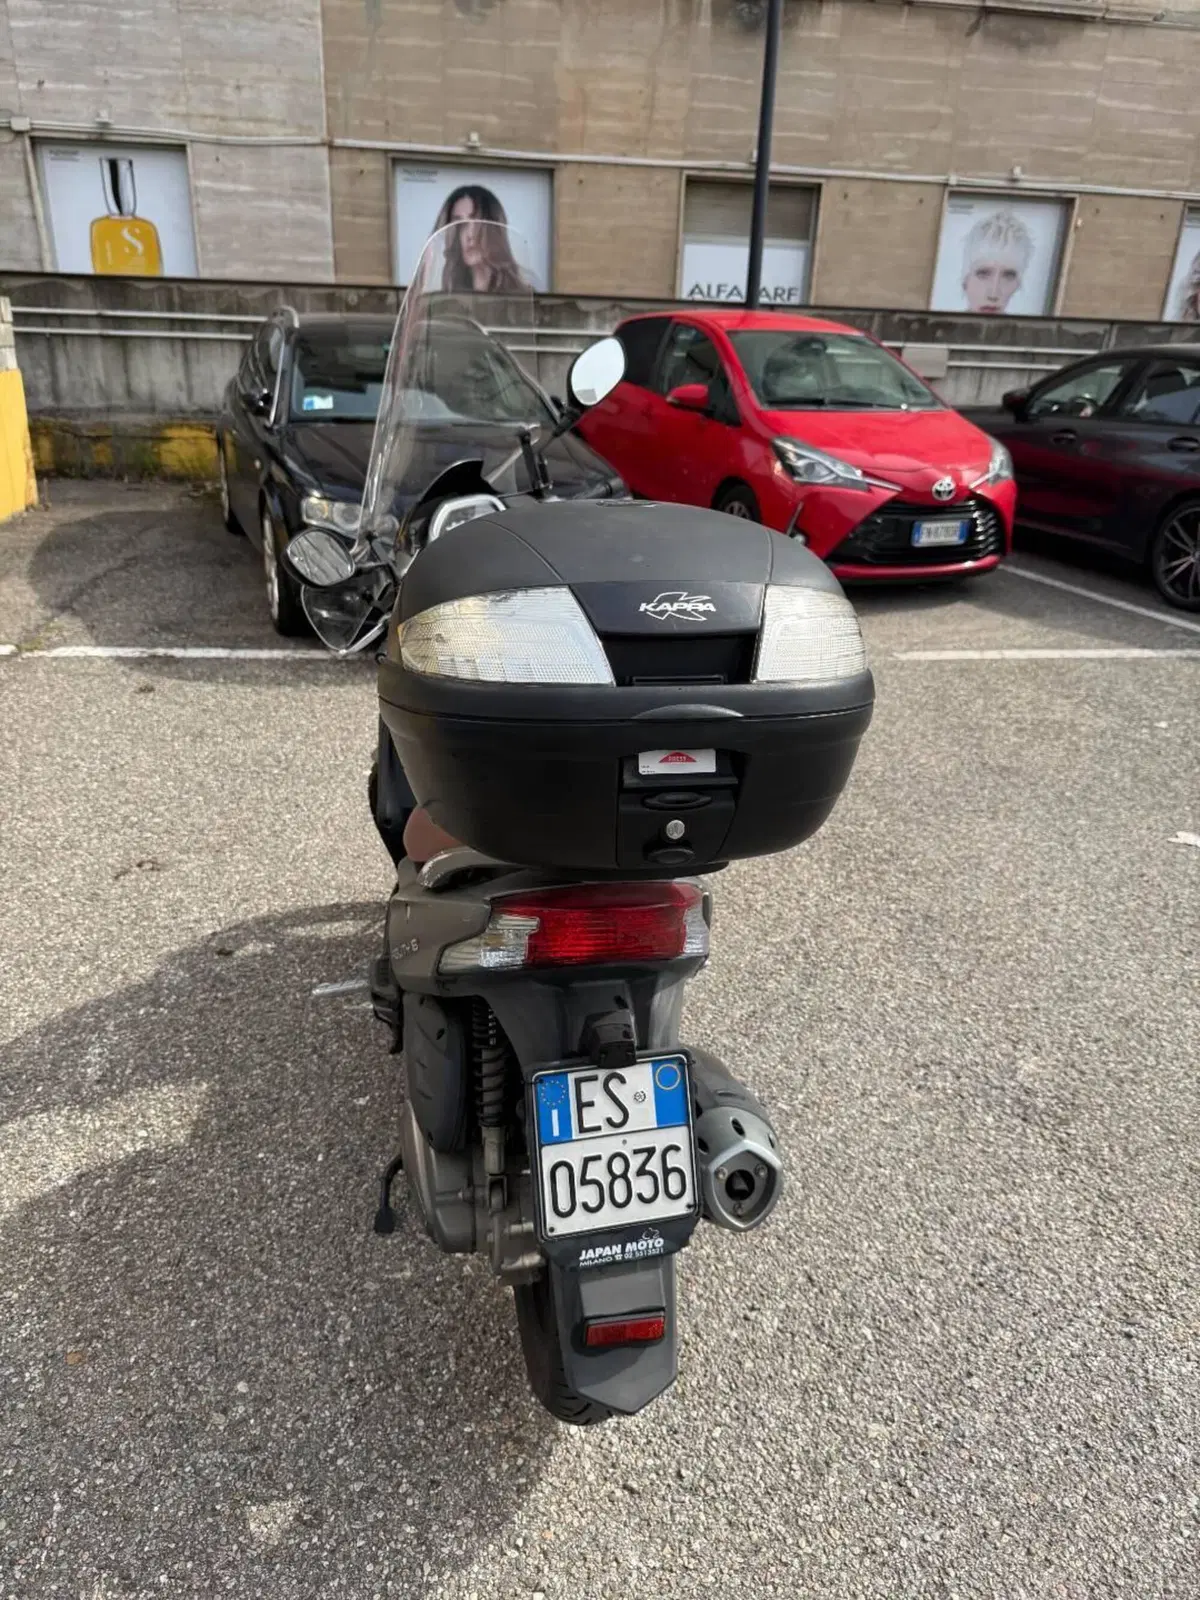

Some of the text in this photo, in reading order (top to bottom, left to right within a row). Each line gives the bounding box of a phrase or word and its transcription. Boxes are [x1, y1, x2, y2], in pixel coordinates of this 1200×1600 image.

[688, 283, 799, 302] ALFAARF
[638, 602, 716, 612] KAPPA
[574, 1072, 630, 1134] ES
[550, 1144, 687, 1218] 05836
[579, 1238, 664, 1260] JAPAN MOTO
[579, 1256, 613, 1267] MILANO
